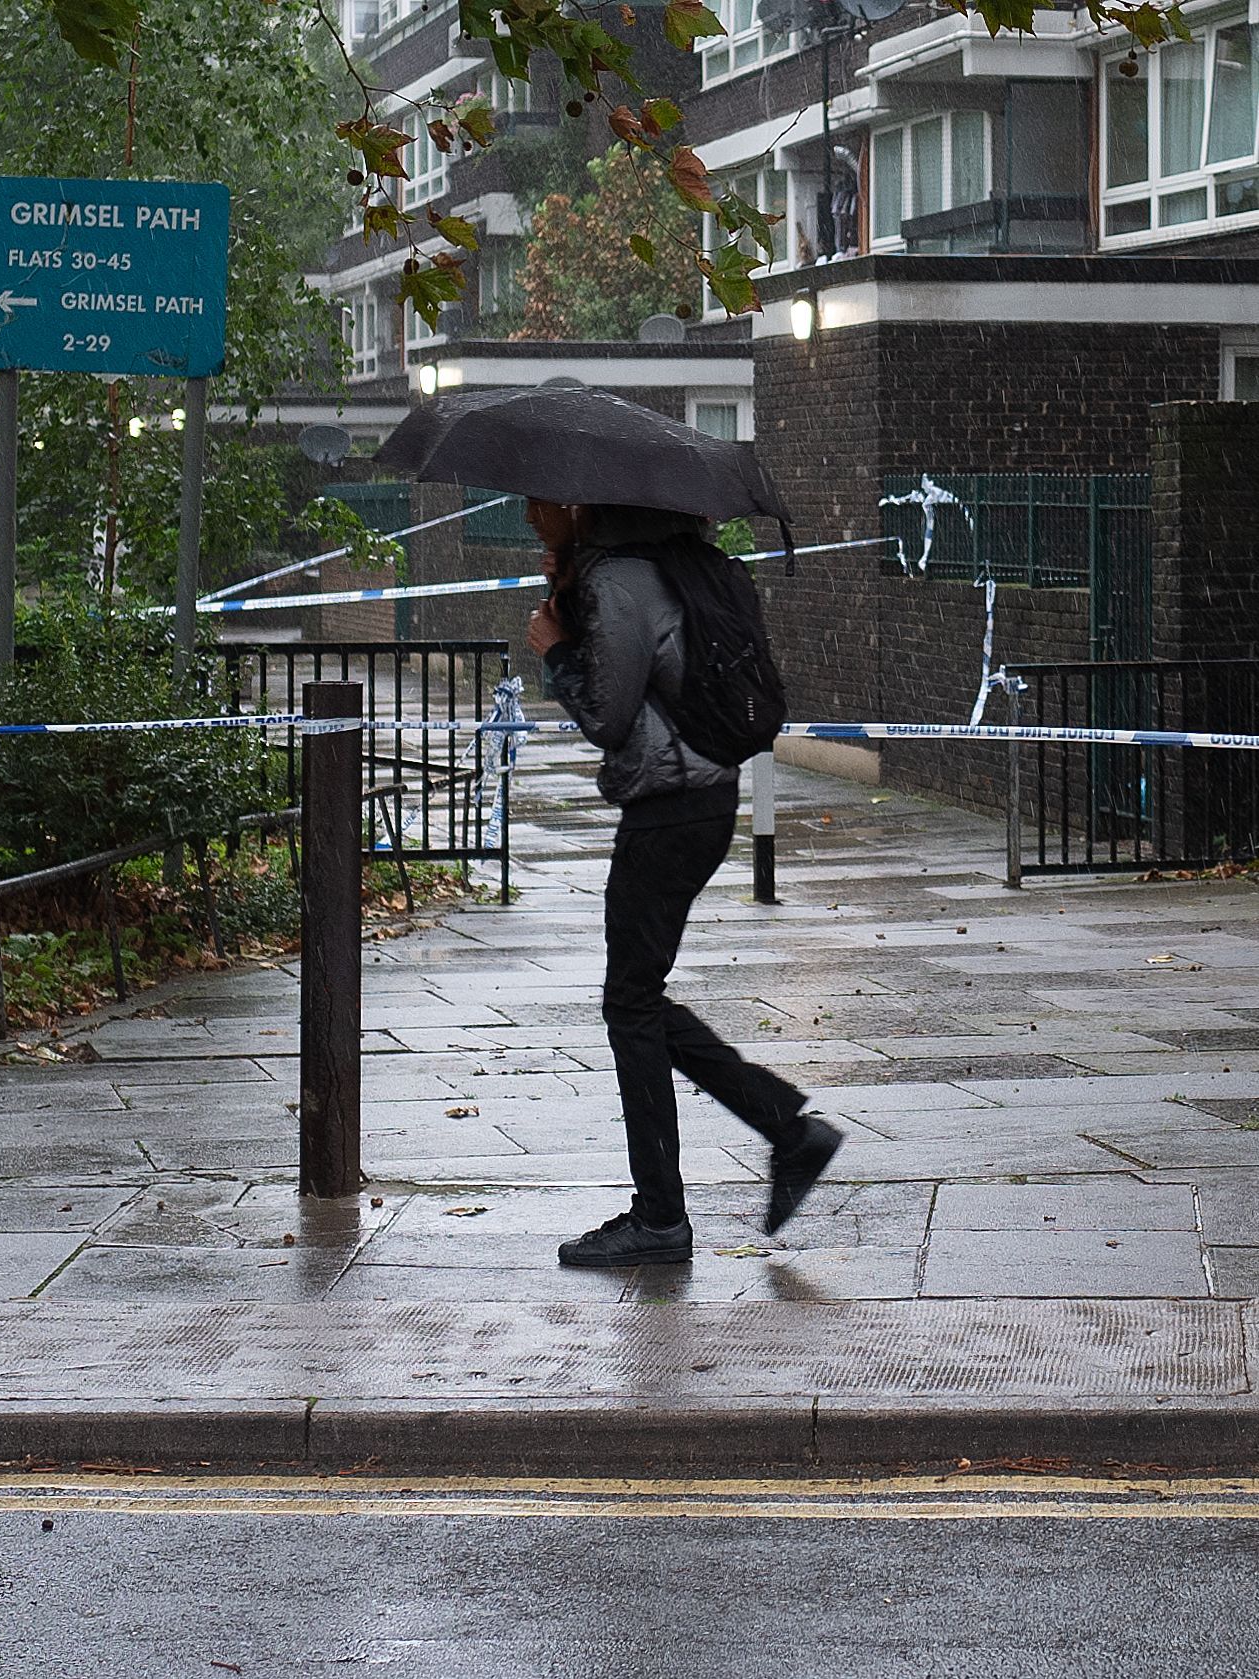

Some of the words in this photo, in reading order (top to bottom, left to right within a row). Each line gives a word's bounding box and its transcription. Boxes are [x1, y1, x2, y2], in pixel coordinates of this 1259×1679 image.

[10, 201, 125, 228] GRIMSEL
[136, 206, 201, 231] PATH
[8, 249, 63, 269] FLATS
[71, 252, 132, 271] 30-45
[60, 291, 147, 313] GRIMSEL
[155, 295, 204, 316] PATH
[62, 333, 111, 352] 2-29
